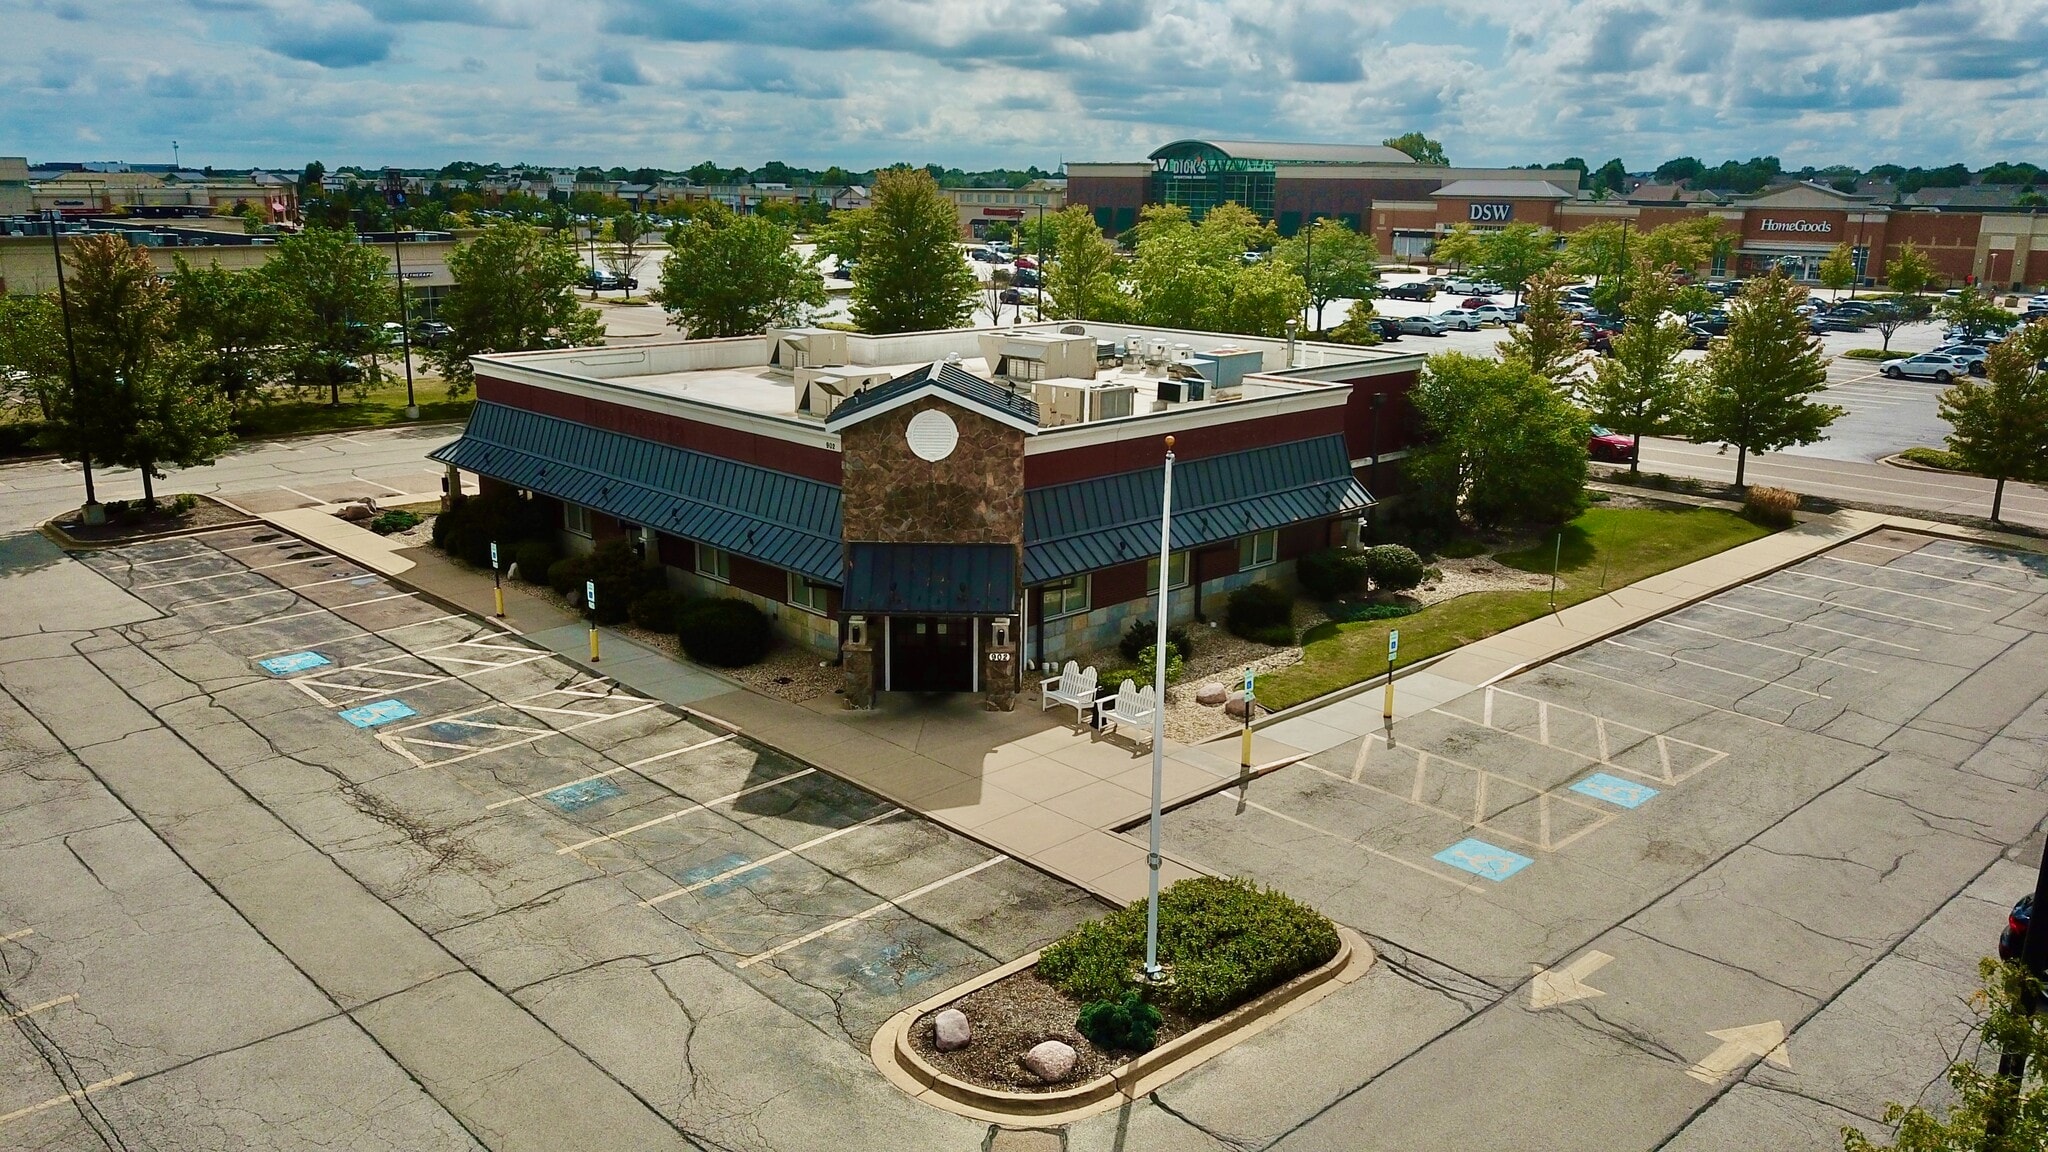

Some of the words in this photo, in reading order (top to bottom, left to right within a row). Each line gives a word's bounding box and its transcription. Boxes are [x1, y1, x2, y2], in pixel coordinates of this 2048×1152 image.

[1173, 159, 1207, 174] DICK'S
[1470, 204, 1510, 220] DSW
[1760, 219, 1832, 232] HomeGoods
[990, 653, 1010, 661] 902
